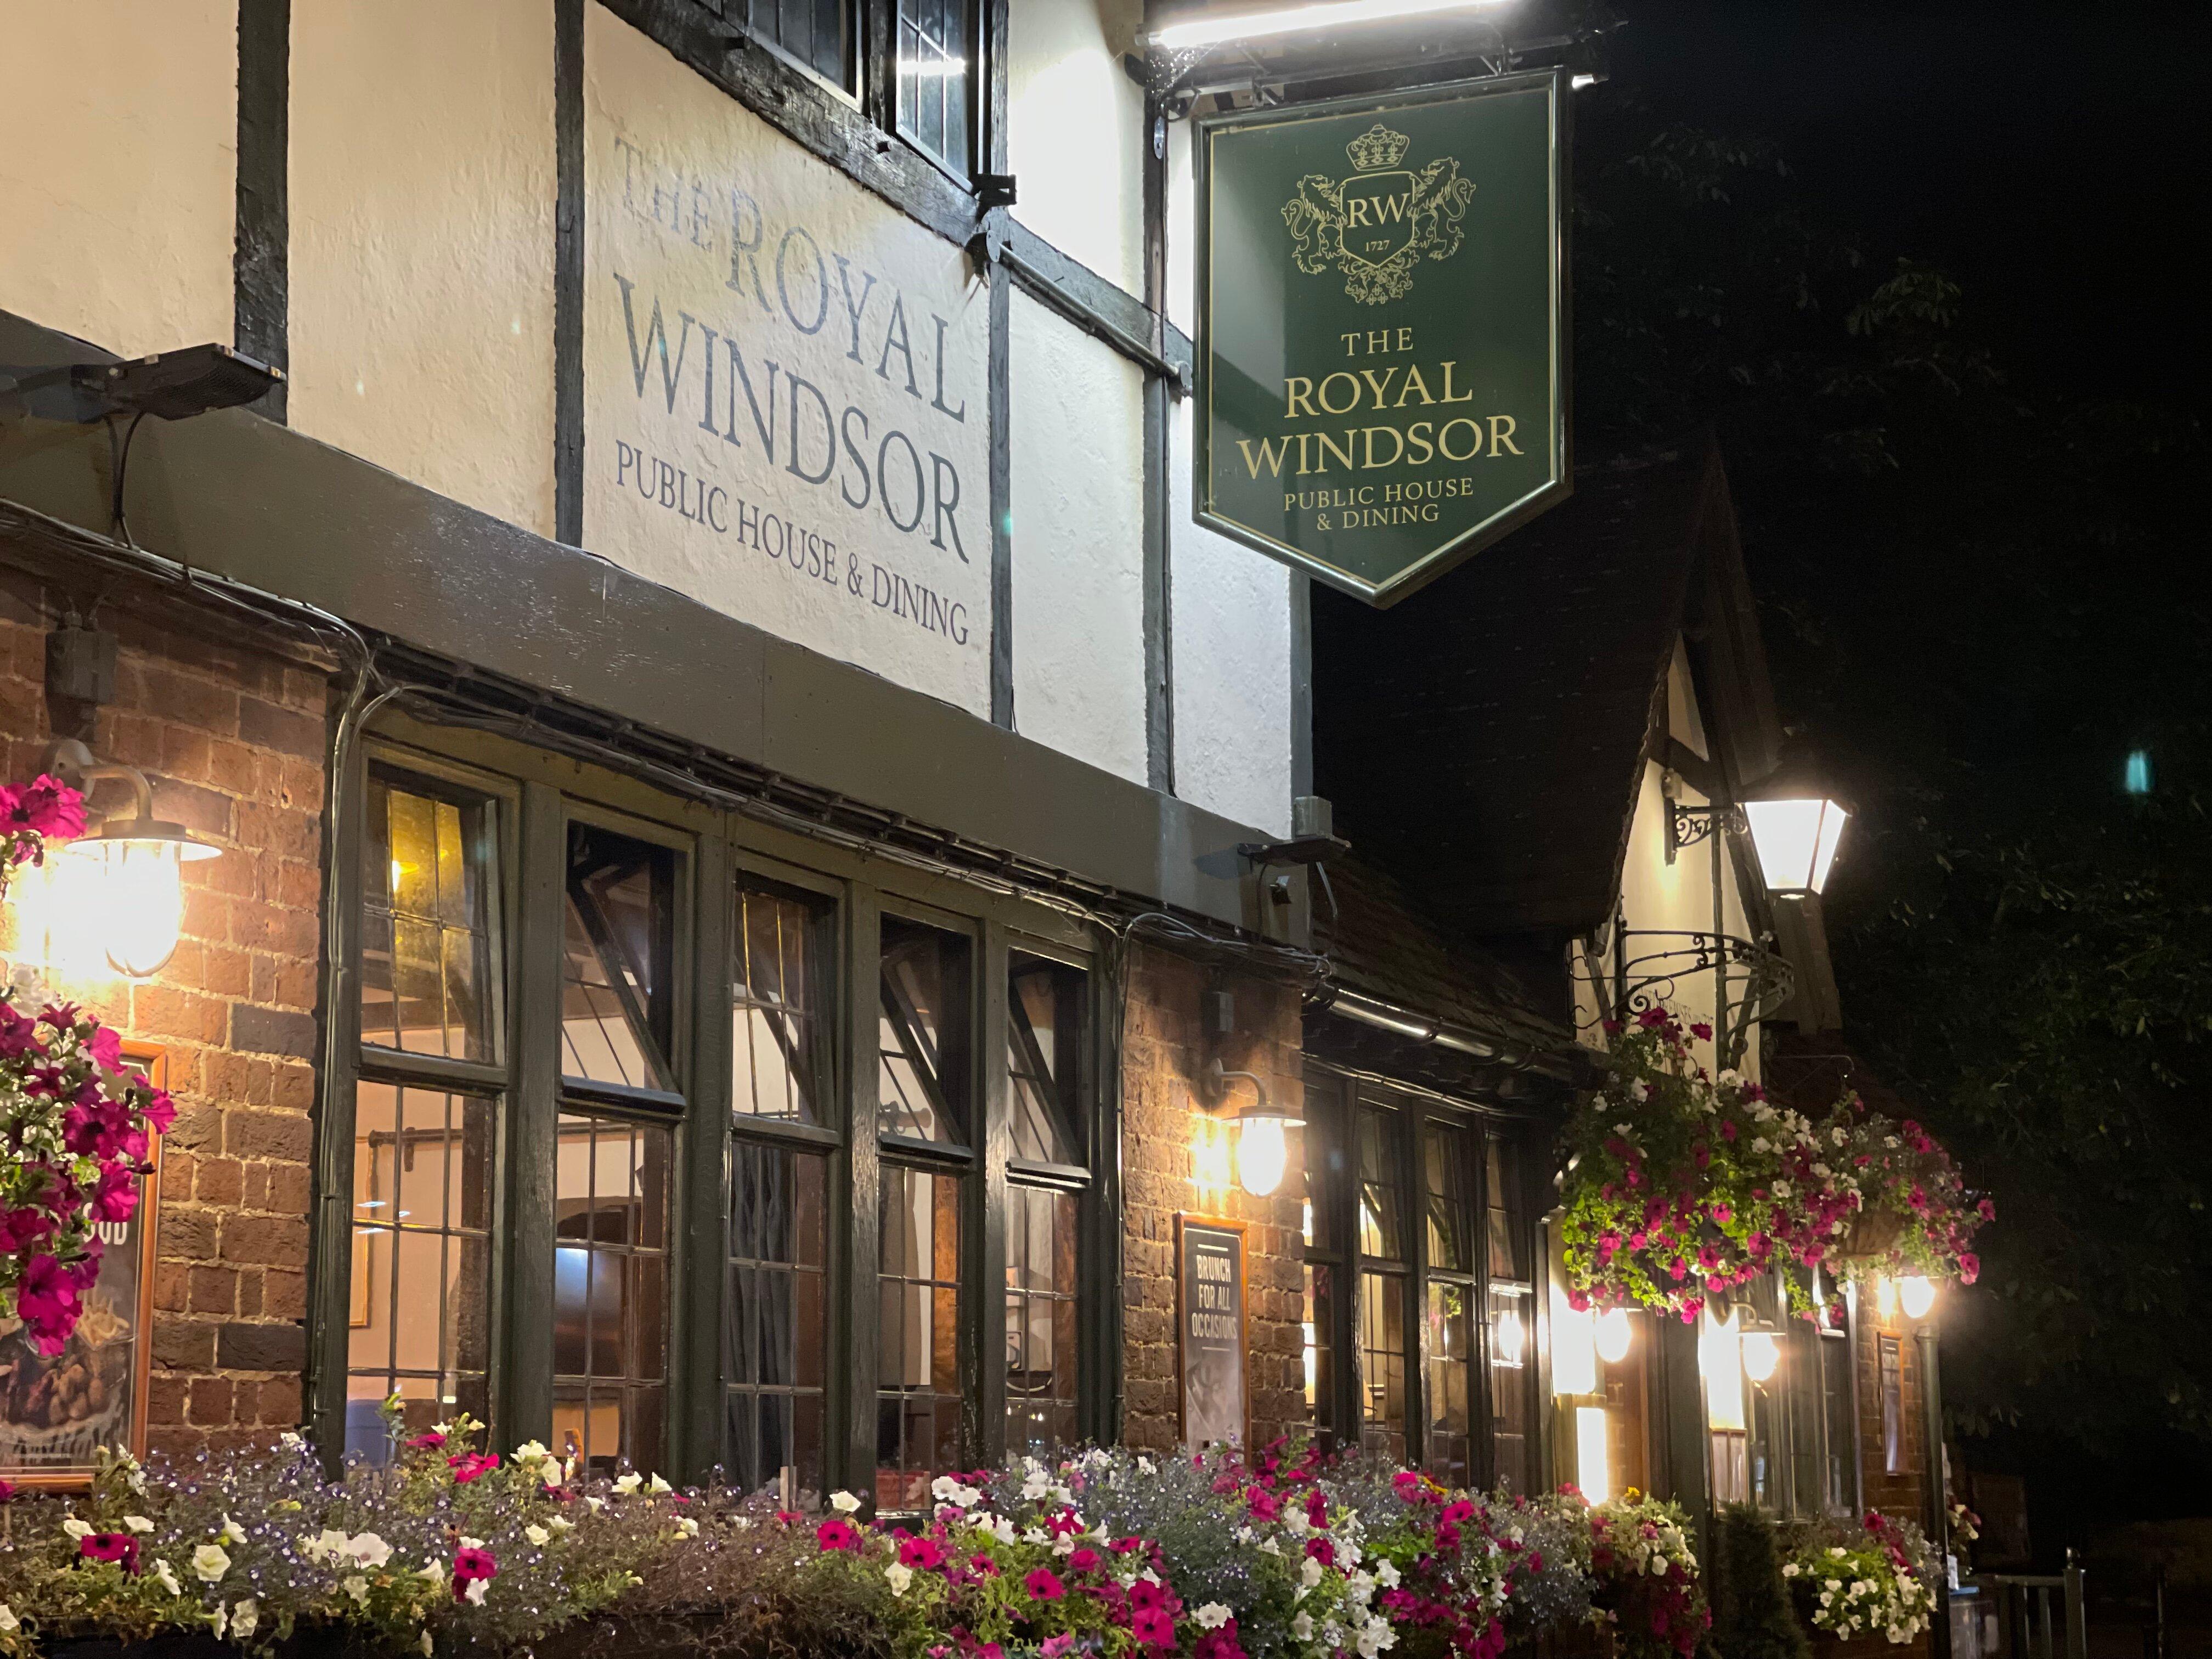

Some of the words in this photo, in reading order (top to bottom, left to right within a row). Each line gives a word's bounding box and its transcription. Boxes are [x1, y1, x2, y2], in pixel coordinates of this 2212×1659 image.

[1347, 193, 1411, 228] RW
[1364, 239, 1390, 252] 1727
[614, 136, 712, 253] THE
[725, 189, 965, 424] ROYAL
[1341, 327, 1414, 357] THE
[1284, 360, 1474, 419] ROYAL
[612, 272, 969, 565] WINDSOR
[1235, 414, 1525, 480] WINDSOR
[1284, 486, 1374, 512] PUBLIC
[1385, 477, 1474, 502] HOUSE
[1317, 512, 1333, 532] &
[1342, 503, 1440, 529] DINING
[616, 439, 727, 533] PUBLIC
[737, 498, 838, 586] HOUSE
[847, 552, 864, 599] &
[871, 563, 969, 646] DINING
[1196, 1254, 1231, 1283] BRUNCH
[1198, 1284, 1215, 1309] FOR
[1217, 1286, 1231, 1311] ALL
[1192, 1312, 1238, 1340] OCCASIONS
